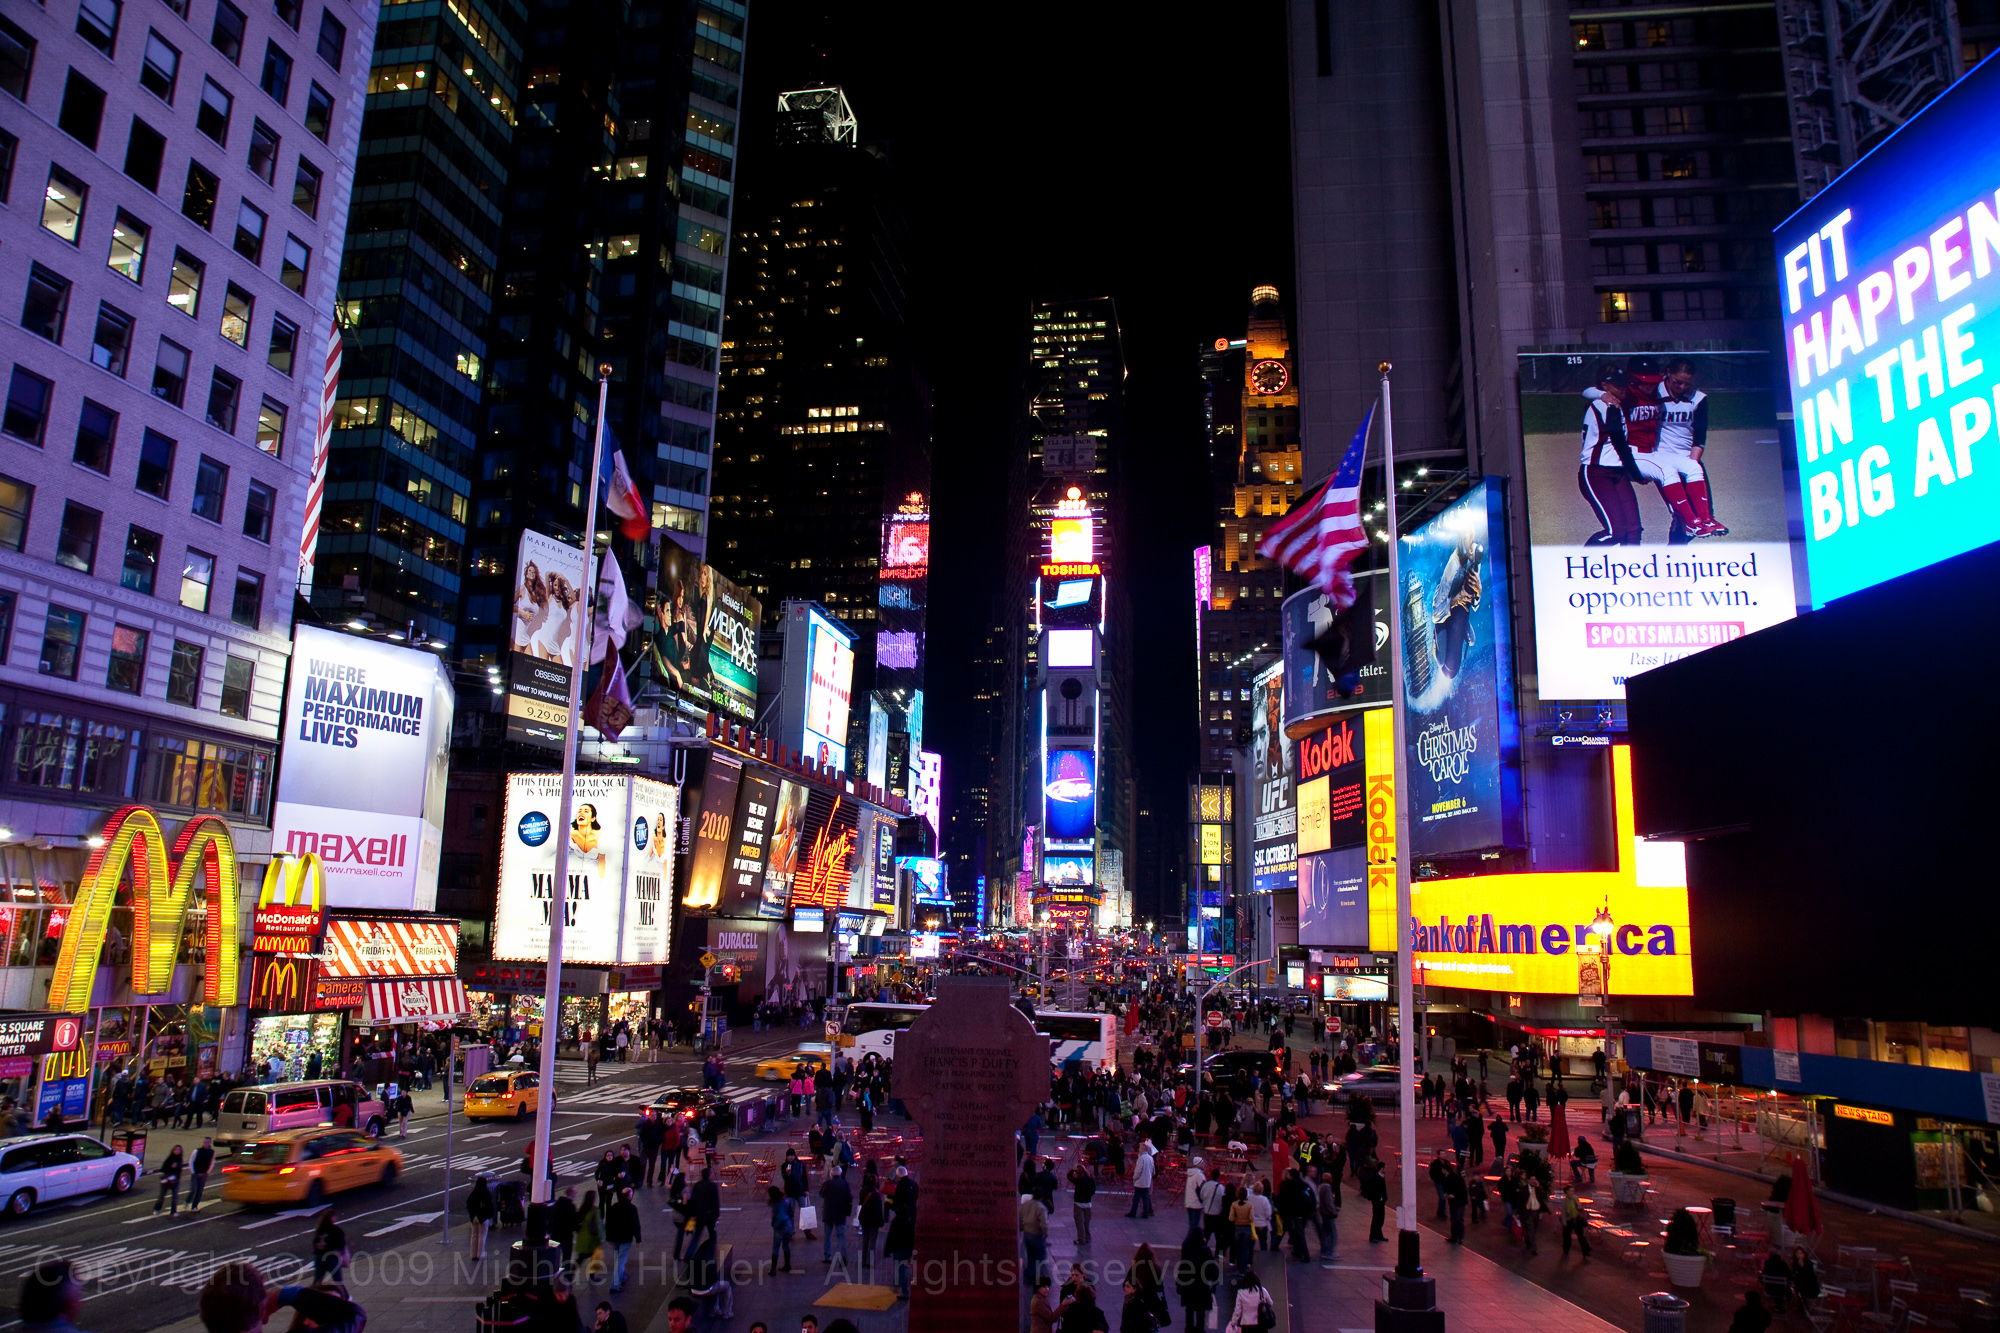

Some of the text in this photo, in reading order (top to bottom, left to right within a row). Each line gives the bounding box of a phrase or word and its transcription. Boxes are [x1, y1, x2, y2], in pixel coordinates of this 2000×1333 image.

[1783, 208, 1852, 315] FIT
[1567, 356, 1582, 365] 215
[1801, 302, 1984, 463] IN THE
[1809, 444, 1896, 542] BIG
[526, 535, 563, 554] MARIAH
[568, 552, 594, 566] CARY
[1041, 564, 1101, 576] TOSHIBA
[1565, 552, 1758, 586] Helped injured
[1568, 583, 1758, 614] opponent win.
[708, 607, 755, 655] MELROSE
[1590, 624, 1741, 646] SPORTSMANSHIP
[731, 640, 757, 676] PLACE
[1629, 651, 1659, 666] Pass
[309, 658, 366, 684] WHERE
[534, 668, 567, 685] OBSESSED
[305, 676, 423, 719] MAXIMUM
[516, 683, 530, 693] WANT
[530, 686, 538, 694] TO
[538, 689, 553, 699] KNOW
[553, 693, 567, 701] WHAT
[302, 701, 421, 736] PERFORMANCE
[526, 706, 567, 724] 9.29.09
[1443, 715, 1450, 733] A
[299, 719, 358, 749] LIVES
[1300, 720, 1355, 780] Kodak
[1416, 723, 1478, 772] CHRISTMAS
[1432, 752, 1469, 784] CAROL
[588, 778, 626, 787] MUSICAL
[526, 788, 543, 796] IS A
[1261, 776, 1289, 814] UFC
[1431, 797, 1466, 814] NOVEMBER 6
[520, 820, 549, 829] WORLDWIDE
[699, 810, 730, 842] 2010
[1301, 806, 1326, 833] smile?
[681, 817, 690, 847] COMING
[1368, 773, 1396, 889] Kodak
[286, 830, 407, 867] maxell
[740, 845, 760, 859] POWERED
[1203, 839, 1219, 848] LION
[1203, 849, 1219, 859] KING
[1254, 842, 1297, 867] SAT. OCTOBER 24
[324, 866, 403, 878] ww.maxell.com
[776, 871, 785, 881] ALL
[785, 873, 795, 883] THE
[1254, 865, 1270, 876] LIVE ON
[530, 873, 590, 900] MAMA
[635, 875, 660, 901] MAMMA
[256, 913, 320, 925] McDonald's
[541, 901, 578, 927] MA!
[265, 924, 308, 933] Restaurant
[718, 932, 759, 949] DURACELL
[361, 946, 391, 956] FRIDAY'S
[415, 947, 442, 956] FRIDAY'S
[476, 966, 547, 979] DIGITA
[405, 996, 425, 1005] FRIDAY'S
[1335, 985, 1384, 999] CHRISTMAS
[8, 1020, 45, 1034] SQUARE
[975, 1048, 1012, 1057] COLONEL
[923, 1056, 1020, 1070] FRANCIS P DUFFY
[66, 1083, 85, 1091] one
[935, 1082, 1006, 1092] CATHOLIC PRIEST
[951, 1102, 989, 1110] CHAPLAIN
[1836, 1106, 1890, 1122] NEWSSTAND
[971, 1114, 1006, 1122] INFANTRY
[942, 1143, 958, 1151] LIFE
[973, 1144, 1005, 1152] SERVICE
[930, 1158, 1007, 1168] GOD AND COUNTRY
